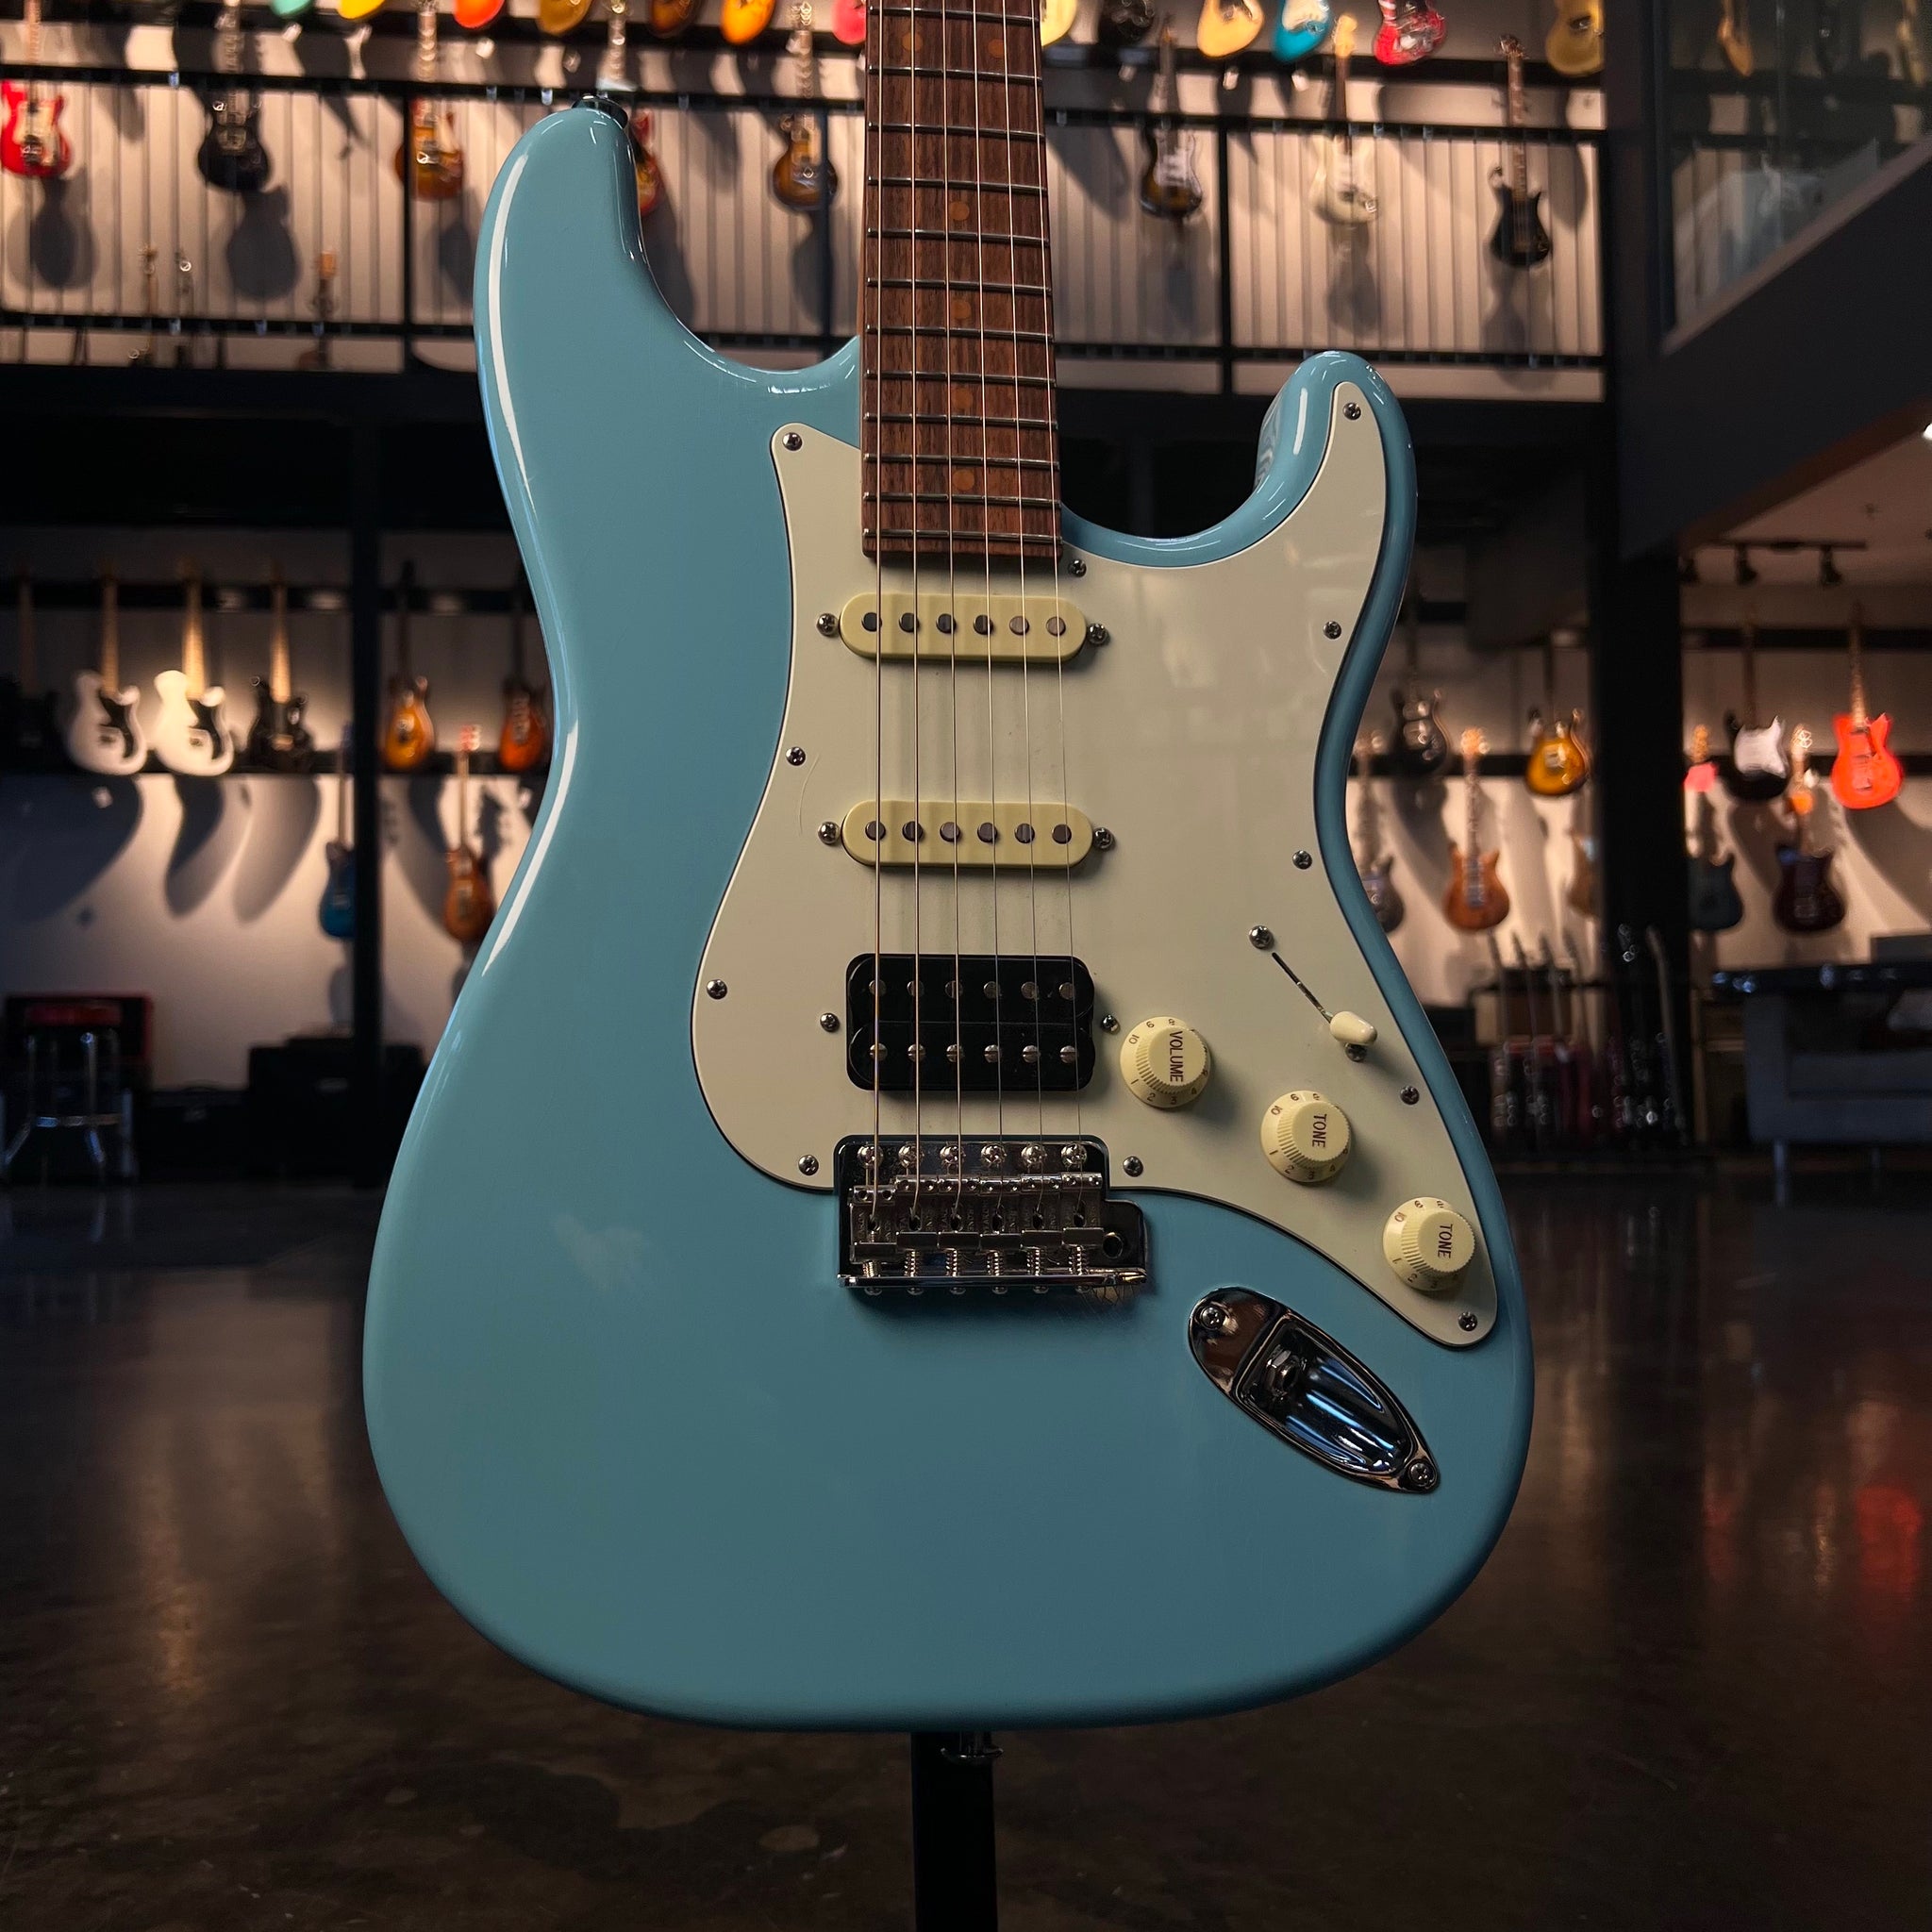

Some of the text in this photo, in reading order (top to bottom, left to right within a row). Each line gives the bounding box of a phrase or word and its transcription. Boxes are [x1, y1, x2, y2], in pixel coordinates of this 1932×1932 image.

[1128, 1034, 1140, 1044] 10
[1169, 1030, 1184, 1082] VOLUME
[1147, 1092, 1156, 1102] 2
[1270, 1105, 1283, 1115] 10
[1312, 1113, 1327, 1148] TONE
[1284, 1164, 1294, 1174] 2
[1437, 1224, 1454, 1258] TONE
